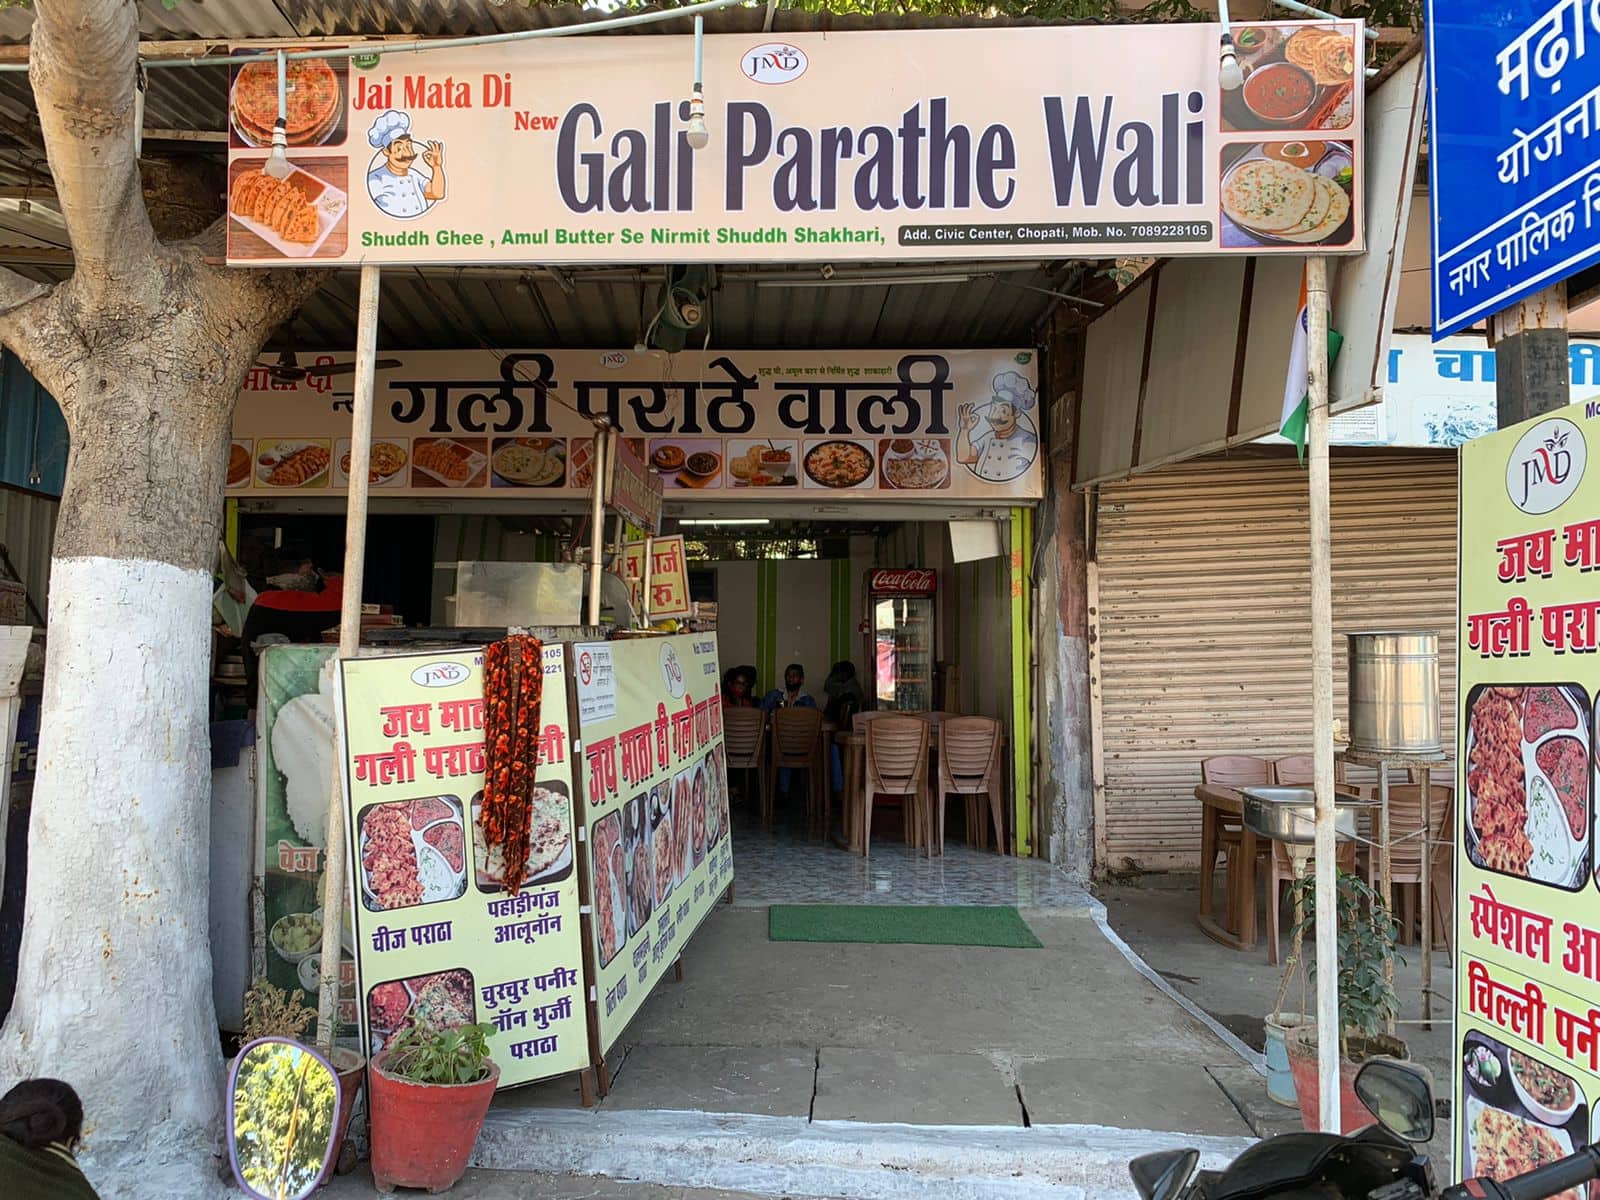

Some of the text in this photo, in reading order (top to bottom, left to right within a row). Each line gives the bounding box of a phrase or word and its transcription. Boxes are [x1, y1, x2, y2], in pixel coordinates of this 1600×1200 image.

[352, 73, 512, 111] Jai Mata Di
[514, 92, 1206, 212] New Gali Parathe Wali
[362, 230, 430, 248] Shuddh
[436, 229, 484, 247] Ghee
[501, 228, 550, 246] Amul
[555, 227, 614, 244] Butter
[620, 227, 645, 243] Se
[650, 226, 710, 242] Nirmit
[716, 225, 787, 243] Shuddh
[793, 224, 886, 244] Shakhari,
[904, 222, 1208, 241] Add. Civic Center, Chopati, Mob. No. 7089228105
[1448, 248, 1492, 296] नगर
[1495, 199, 1577, 271] पालिक
[389, 353, 557, 432] गली
[574, 357, 759, 433] पराठे
[773, 354, 954, 435] वाली
[1497, 529, 1556, 582] जय
[1467, 597, 1533, 658] गली
[380, 703, 432, 737] जय
[354, 742, 417, 787] गली
[586, 736, 616, 807] जय
[619, 722, 654, 789] माता
[372, 921, 452, 952] चीज पराठा
[1469, 884, 1554, 964] स्पेशल
[481, 967, 577, 1009] चुरचुर पनीर
[1468, 960, 1546, 1046] चिल्ली
[509, 1034, 559, 1060] पराठा
